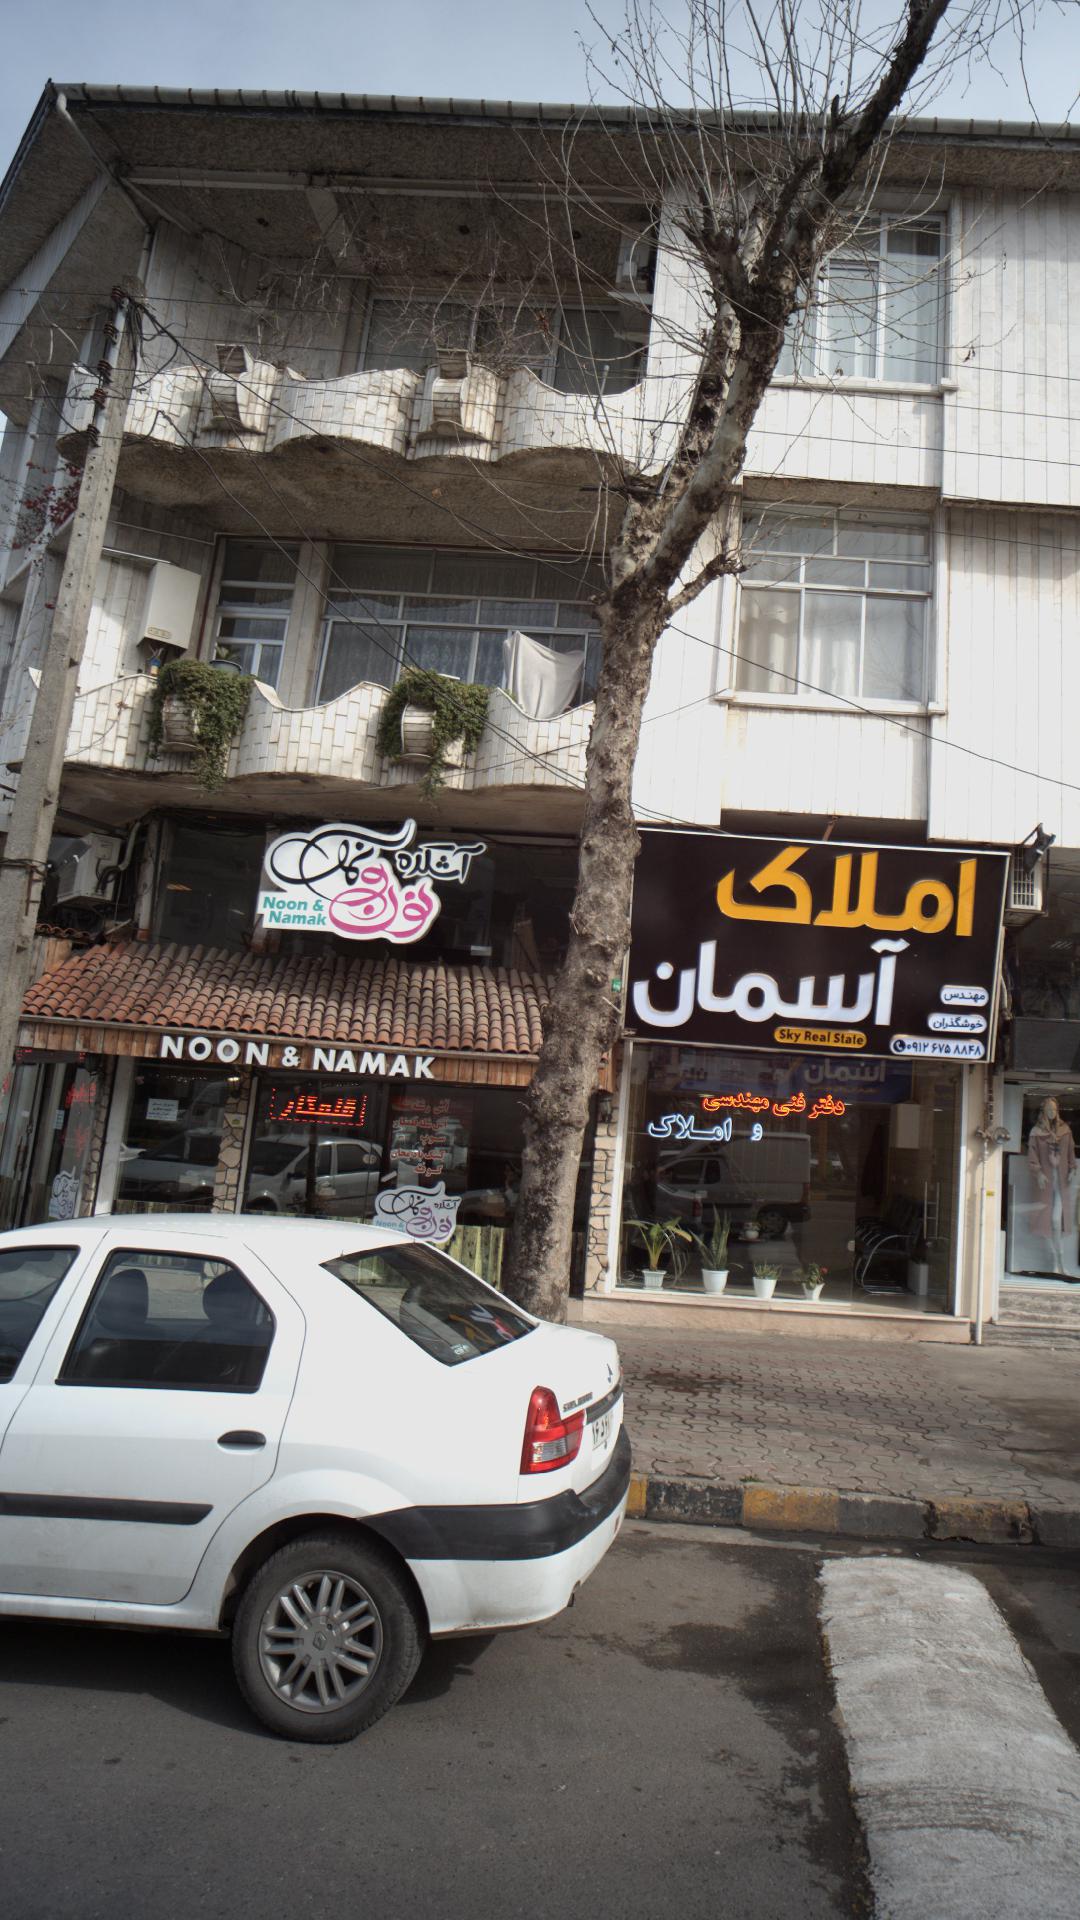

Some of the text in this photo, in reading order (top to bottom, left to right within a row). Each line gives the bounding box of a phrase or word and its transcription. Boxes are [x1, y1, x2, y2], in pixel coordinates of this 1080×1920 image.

[716, 846, 977, 938] املاک
[263, 896, 325, 912] Noon &
[269, 911, 327, 926] Namak
[632, 938, 910, 1028] آسمان
[943, 991, 985, 1003] مهندس
[932, 1017, 983, 1031] خوشگذران
[779, 1028, 864, 1045] Sky Real State
[160, 1035, 436, 1080] NOON & NAMAK
[703, 1091, 846, 1119] دفتر فنی مهندسی
[647, 1114, 764, 1143] و املاک
